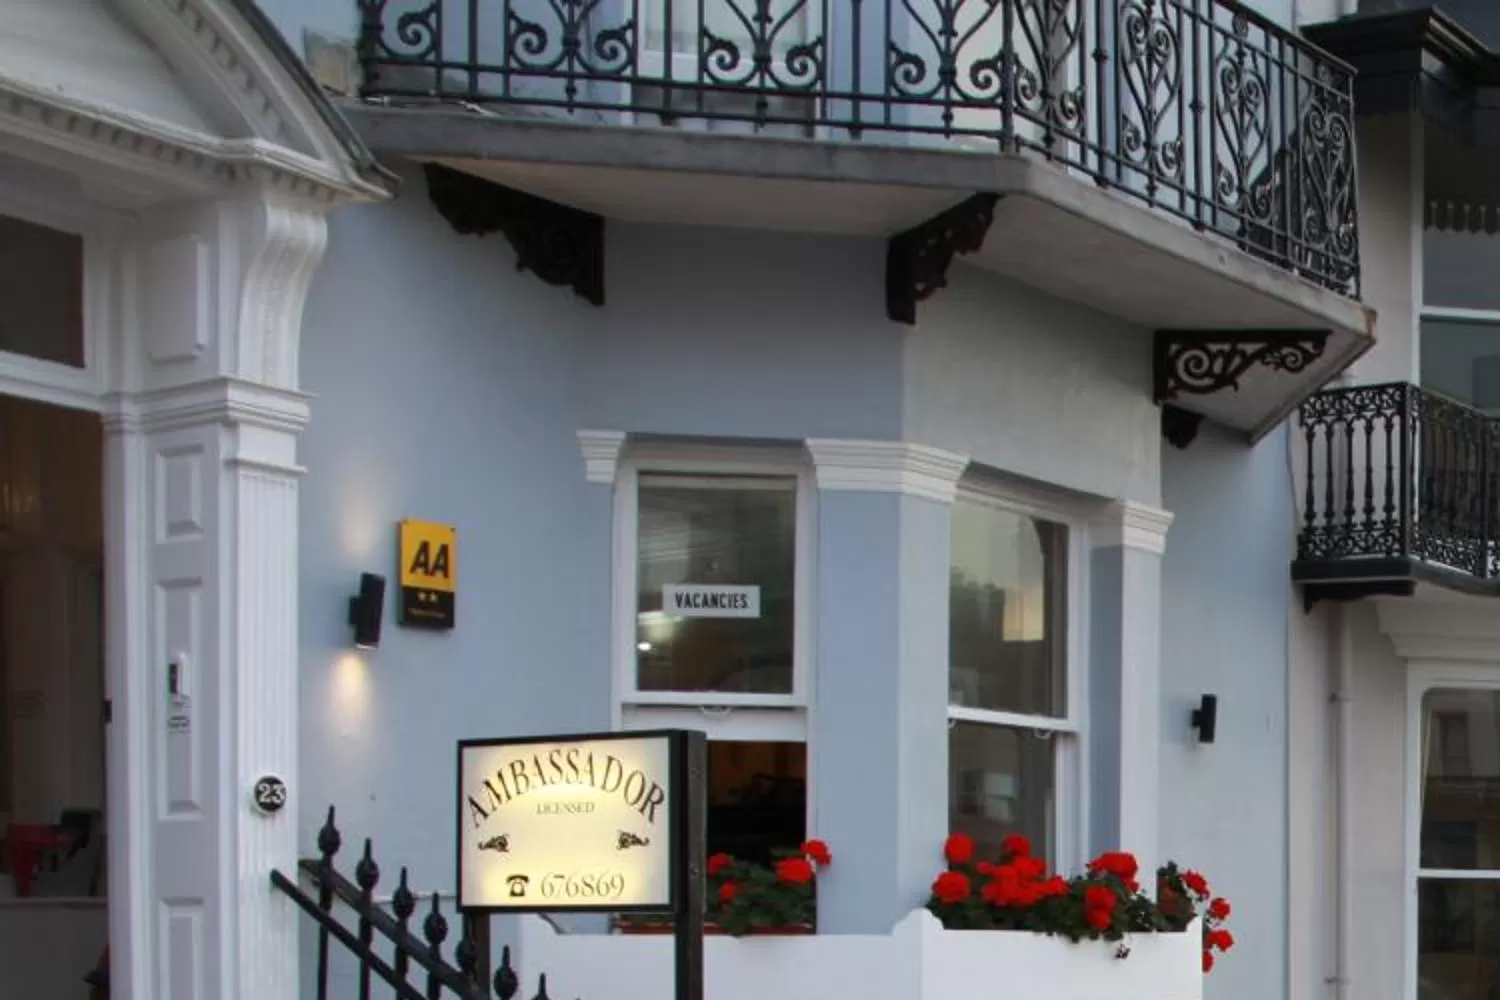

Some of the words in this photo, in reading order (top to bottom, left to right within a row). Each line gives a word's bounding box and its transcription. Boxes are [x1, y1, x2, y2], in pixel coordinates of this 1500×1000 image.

[409, 541, 450, 580] AA
[674, 592, 750, 609] VACANCIES
[259, 783, 286, 804] 23
[467, 749, 665, 828] AMBASSADOR
[536, 801, 596, 815] LICENSED
[540, 871, 626, 899] 676869
